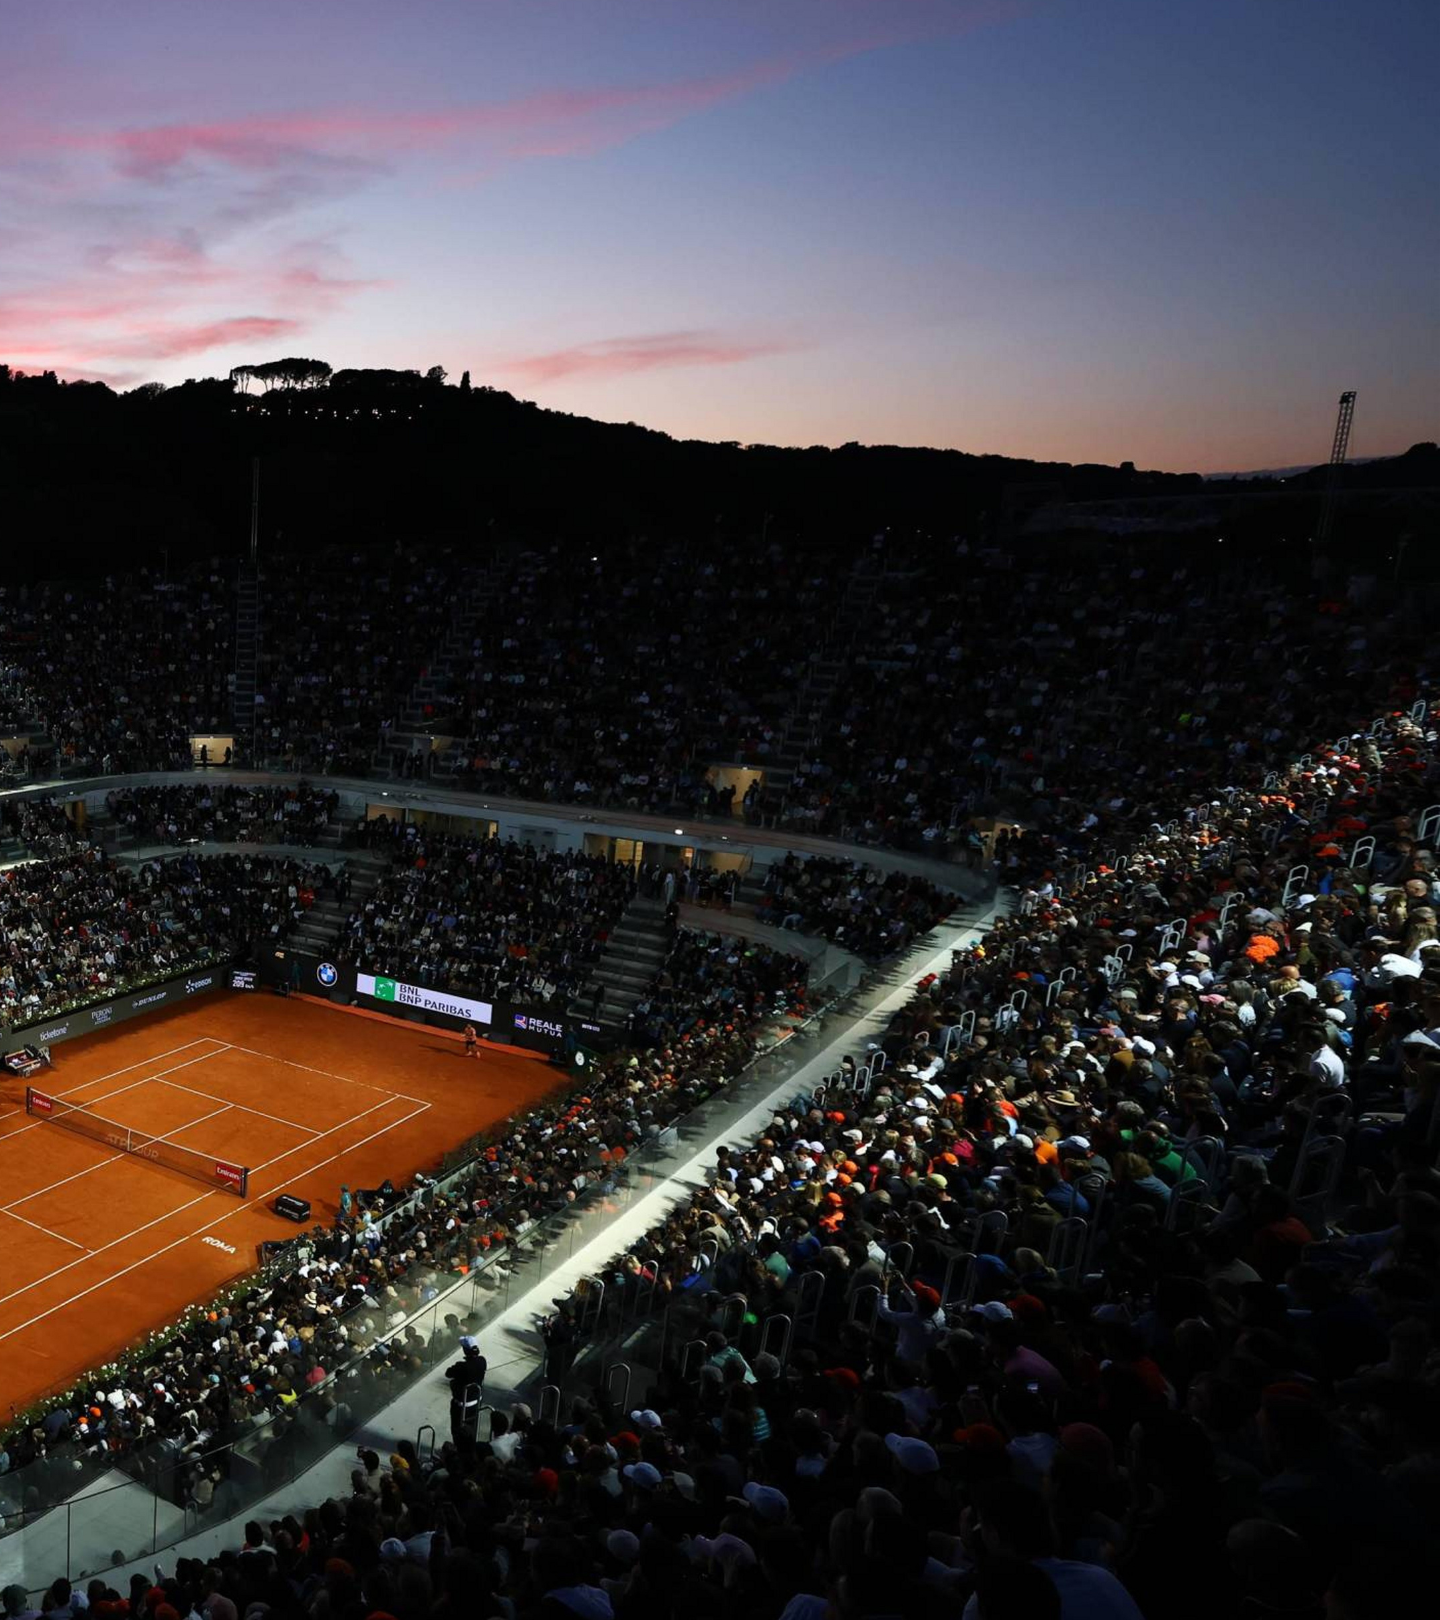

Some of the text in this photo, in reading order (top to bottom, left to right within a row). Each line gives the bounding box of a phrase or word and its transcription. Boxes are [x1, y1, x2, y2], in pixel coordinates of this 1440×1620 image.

[232, 980, 245, 988] 209
[399, 984, 421, 996] BNL
[138, 991, 167, 1006] DUNLOP
[399, 993, 472, 1018] BNP PARIBAS
[529, 1018, 563, 1032] REALE
[529, 1026, 562, 1038] MUTUA
[201, 1236, 237, 1254] ROMA
